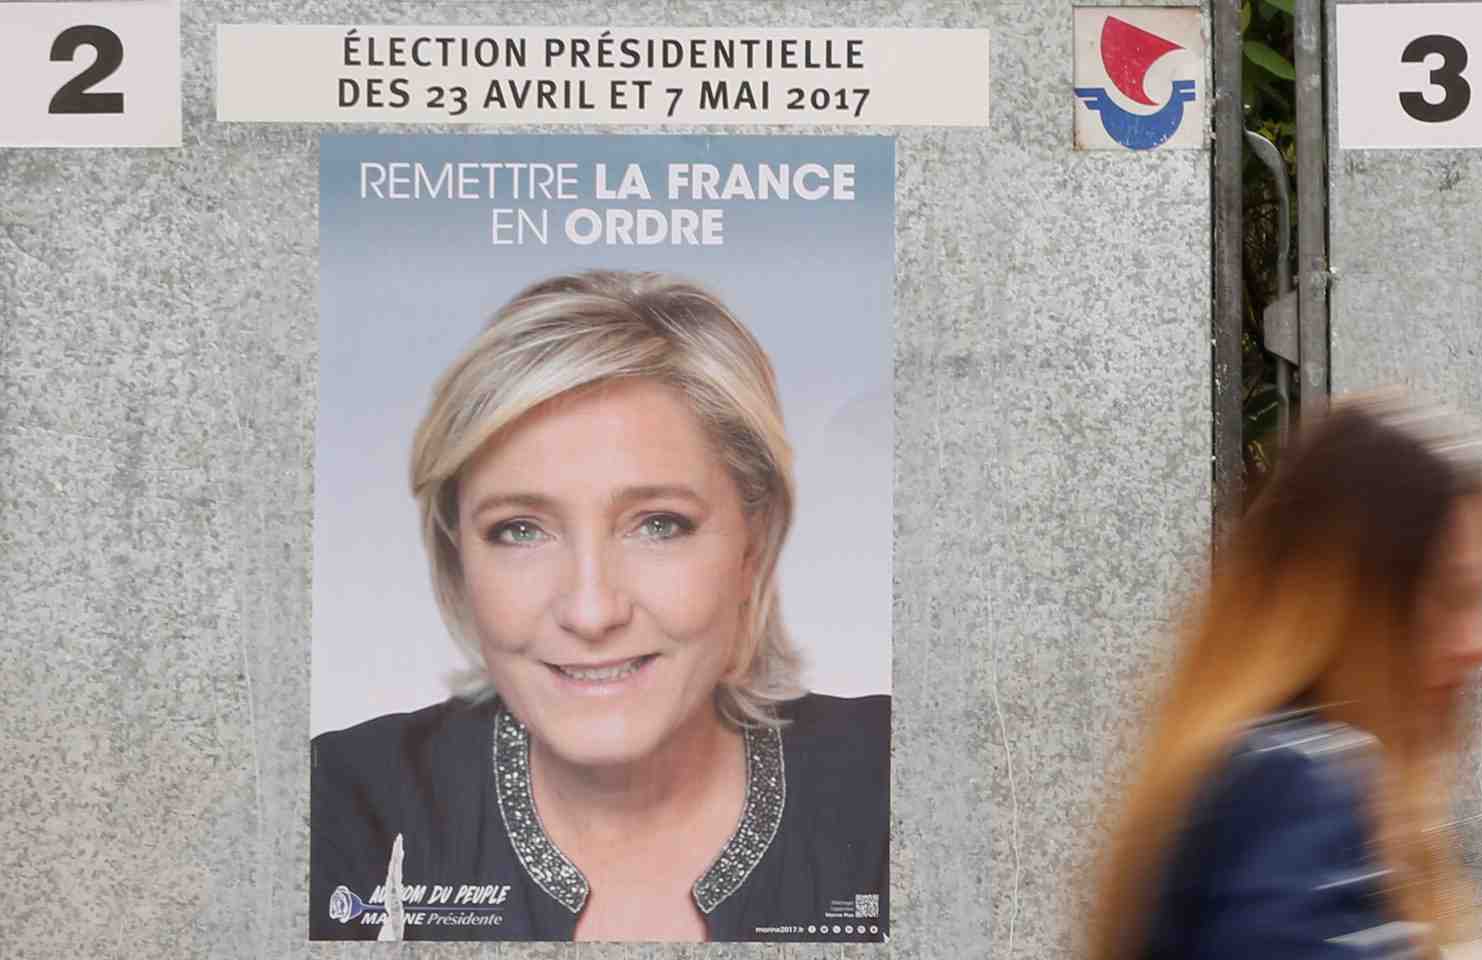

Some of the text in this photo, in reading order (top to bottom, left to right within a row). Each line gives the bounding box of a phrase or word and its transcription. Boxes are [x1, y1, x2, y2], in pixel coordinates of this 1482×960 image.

[343, 29, 865, 70] ÉLECTION PRÉSIDENTIELLE
[48, 24, 125, 115] 2
[1399, 34, 1472, 124] 3
[338, 78, 871, 117] DES 23 AVRIL ET 7 MAI 2017
[360, 162, 856, 201] REMETTRE LA FRANCE
[492, 207, 725, 246] EN ORDRE
[427, 885, 452, 904] DU
[454, 885, 512, 905] PEUPLE
[361, 911, 504, 926] MANE Présidente
